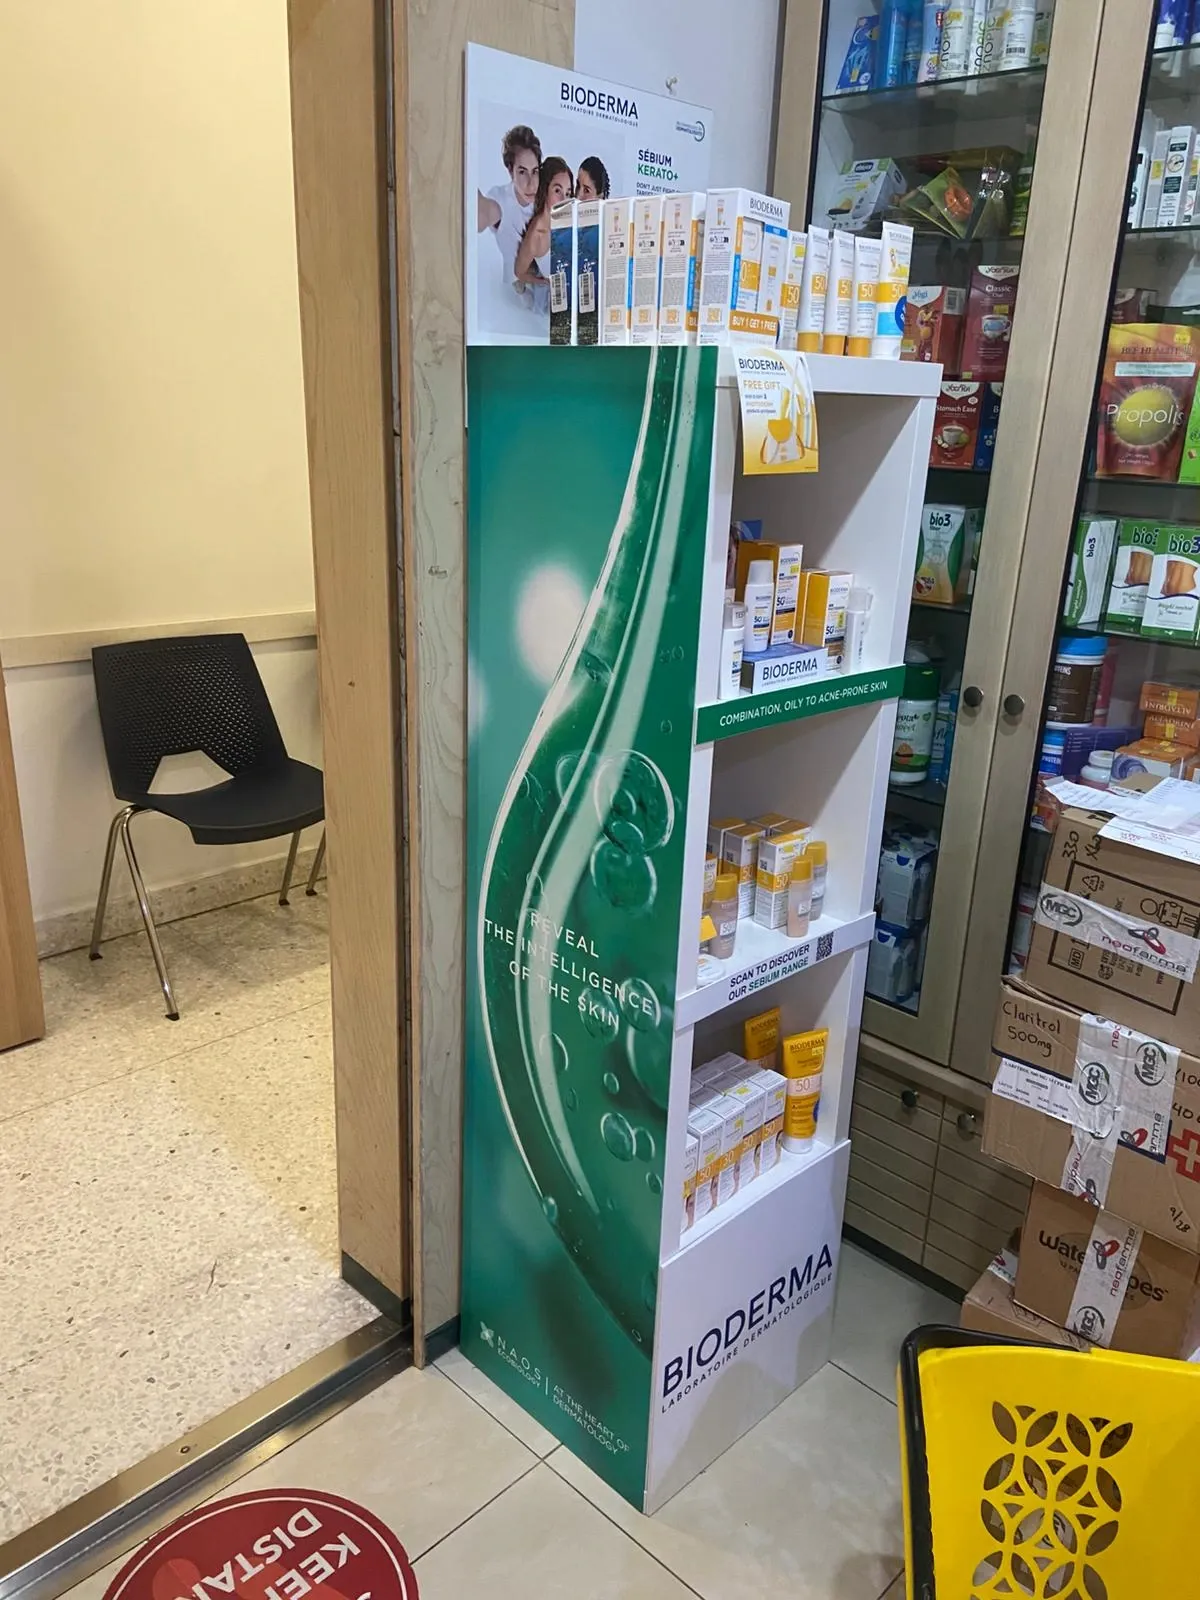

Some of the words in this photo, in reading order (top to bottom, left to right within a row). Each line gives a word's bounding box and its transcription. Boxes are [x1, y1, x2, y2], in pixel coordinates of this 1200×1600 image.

[560, 82, 639, 120] BIODERMA
[560, 103, 594, 117] LABORATOIRE
[637, 163, 679, 181] KERATO+
[638, 148, 672, 167] SÉBIUM
[750, 197, 783, 218] BIODERMA
[787, 286, 799, 303] 50
[861, 284, 873, 298] 50
[985, 284, 1012, 293] Classic
[732, 315, 745, 326] BUY
[750, 318, 760, 329] GET
[764, 320, 777, 332] FREE
[739, 358, 786, 373] BIODERMA
[743, 380, 763, 390] FREE
[764, 380, 781, 391] GIFT
[1106, 403, 1185, 428] Propolis
[929, 512, 951, 526] bio3
[1086, 537, 1096, 558] bio3
[1169, 534, 1200, 554] bio3
[762, 657, 818, 681] BIODERMA
[784, 698, 804, 712] OILY
[804, 695, 818, 706] TO
[818, 683, 869, 703] ACNE-PRONE
[869, 680, 889, 693] SKIN
[1062, 830, 1080, 860] 330
[1045, 898, 1077, 919] MGC
[530, 912, 599, 958] REVEAL
[484, 918, 514, 946] THE
[521, 937, 653, 1016] INTELLIGENCE
[729, 971, 754, 988] SCAN
[755, 963, 768, 975] TO
[768, 943, 810, 970] DISCOVER
[1102, 934, 1187, 973] neofarma
[509, 961, 531, 980] OF
[538, 973, 570, 1004] THE
[578, 995, 619, 1027] SKIN
[728, 985, 747, 1001] OUR
[781, 957, 809, 975] RANGE
[1002, 1001, 1061, 1034] Claritrol
[789, 1038, 825, 1052] BIODERMA
[1007, 1026, 1052, 1058] 500mg
[1141, 1046, 1157, 1080] MGC
[795, 1078, 811, 1093] 50
[1085, 1067, 1101, 1099] MGC
[1110, 1227, 1136, 1297] neofarma
[663, 1243, 833, 1398] BIODERMA
[497, 1336, 541, 1380] NAOS
[661, 1347, 739, 1414] LABORATOIRE
[743, 1272, 833, 1348] DERMATOLOGIQUE
[553, 1385, 563, 1396] AT
[566, 1393, 583, 1415] THE
[585, 1410, 614, 1440] HEART
[617, 1439, 630, 1452] OF
[553, 1395, 618, 1455] DERMATOLOGY
